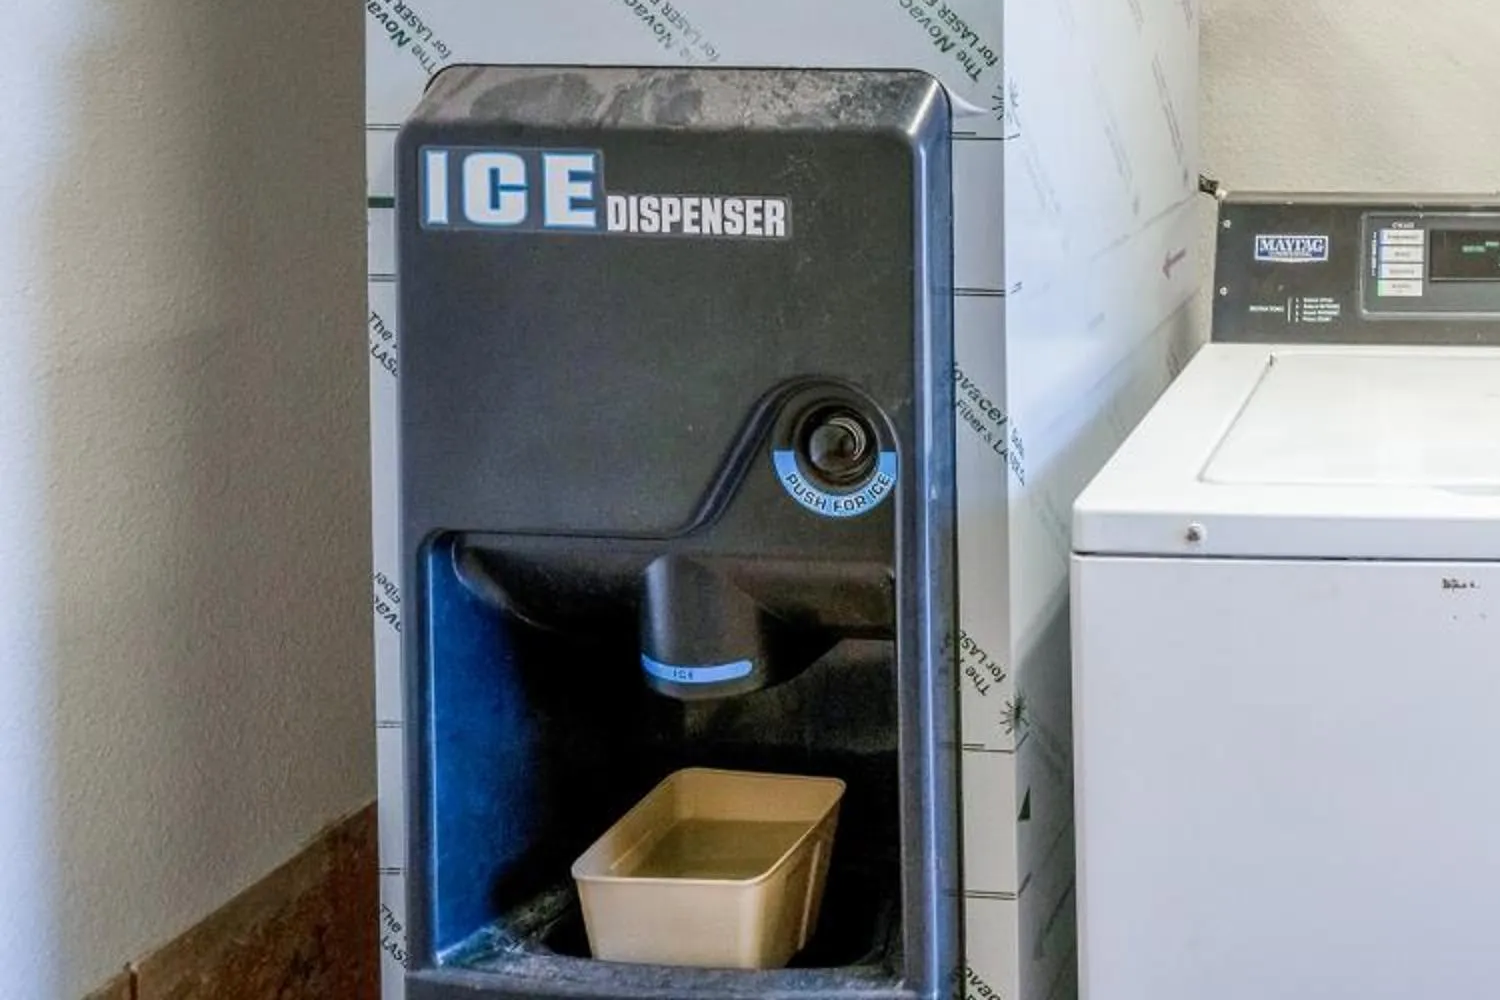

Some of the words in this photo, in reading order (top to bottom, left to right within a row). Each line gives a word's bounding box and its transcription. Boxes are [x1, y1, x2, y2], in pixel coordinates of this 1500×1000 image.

[393, 0, 433, 42] LASER
[937, 5, 979, 48] LASER
[411, 44, 437, 75] The
[956, 50, 982, 83] The
[978, 43, 998, 67] for
[425, 150, 596, 227] ICE
[606, 194, 786, 237] DISPENSER
[1260, 239, 1324, 252] MAYTAG
[786, 473, 827, 511] PUSH
[833, 495, 867, 512] FOR
[867, 474, 891, 501] ICE
[965, 666, 991, 696] The
[985, 662, 1006, 683] for
